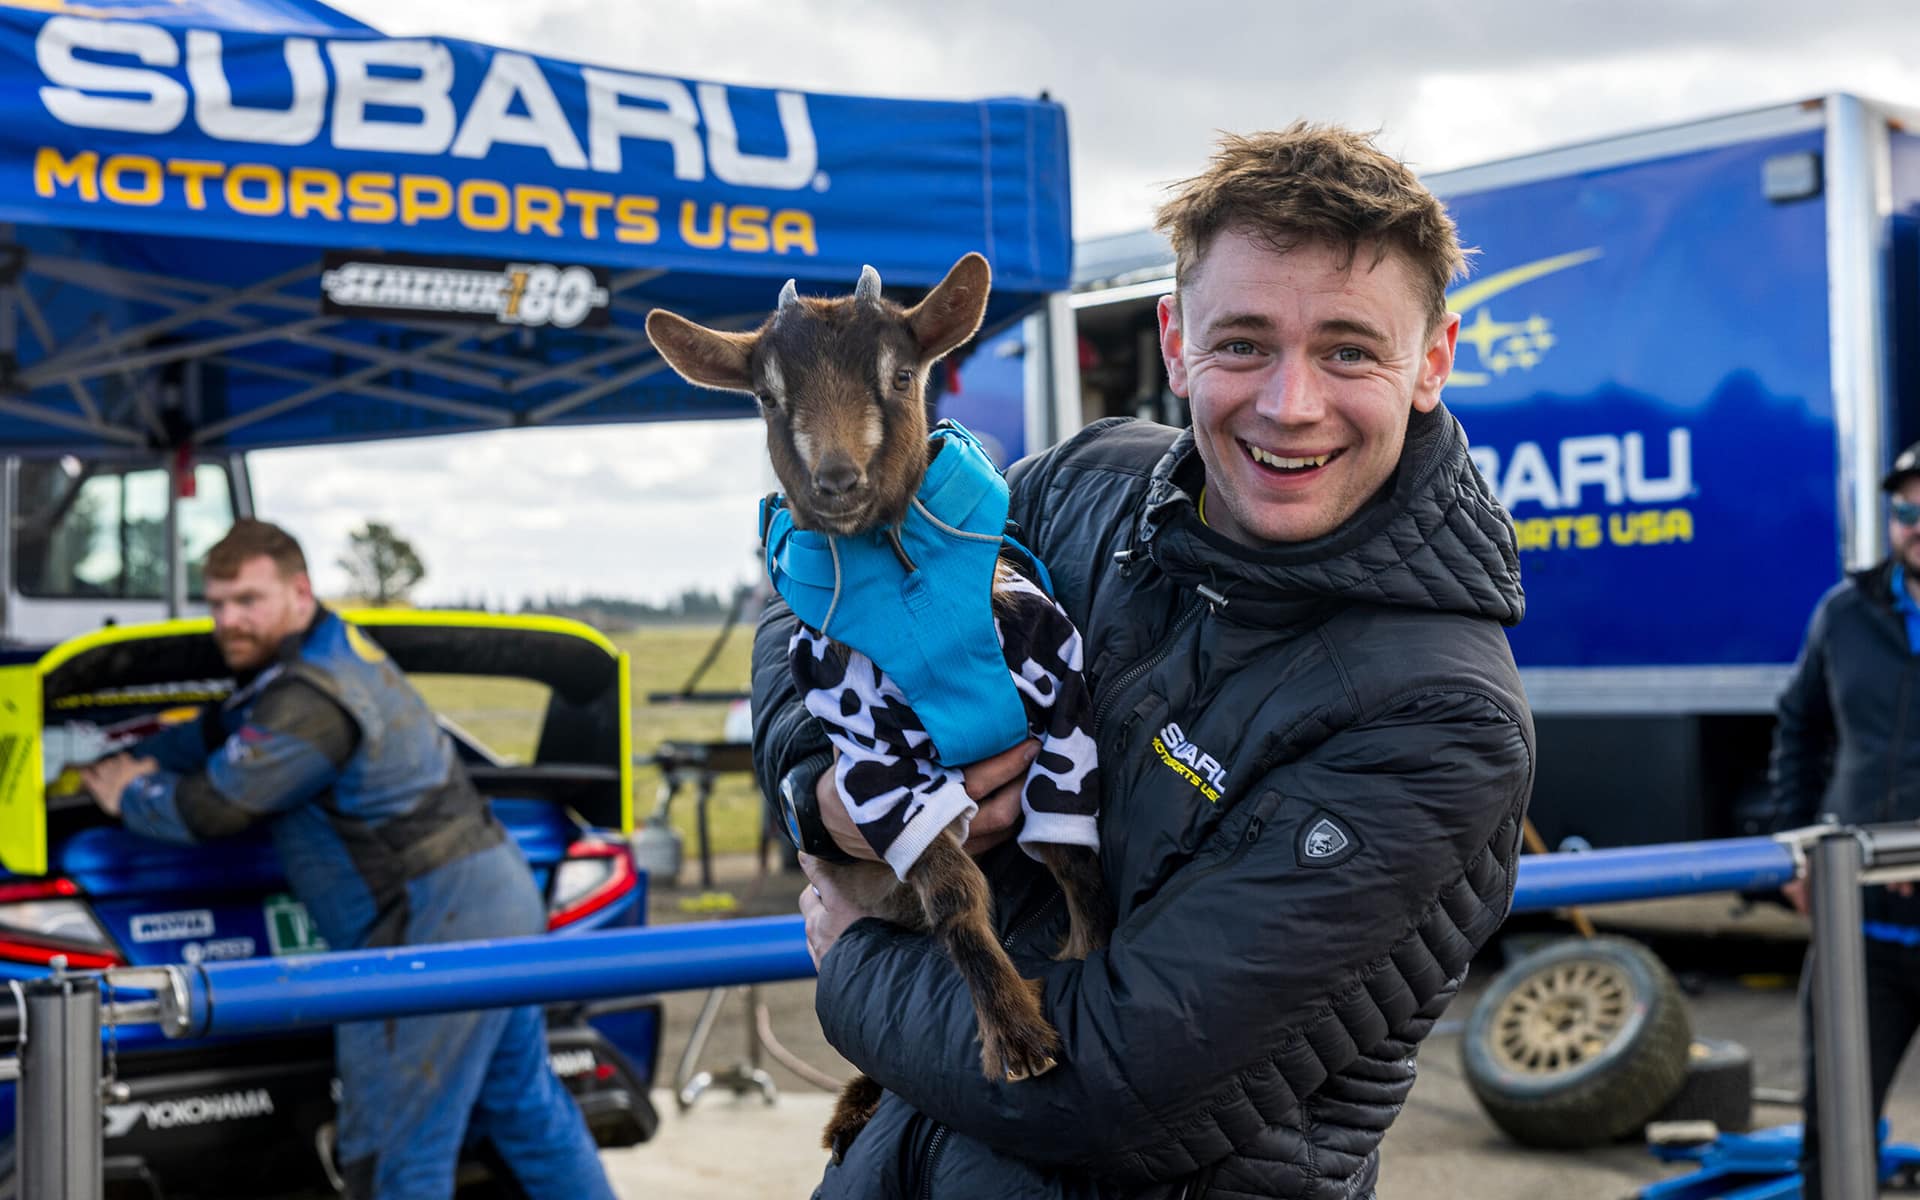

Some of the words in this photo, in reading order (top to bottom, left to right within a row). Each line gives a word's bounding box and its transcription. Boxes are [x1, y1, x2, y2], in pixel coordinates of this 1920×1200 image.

[35, 17, 818, 190] SUBARU
[34, 147, 659, 242] MOTORSPORTS
[680, 201, 816, 254] USA
[1609, 508, 1693, 546] USA
[144, 1089, 274, 1129] YOKOHAMA
